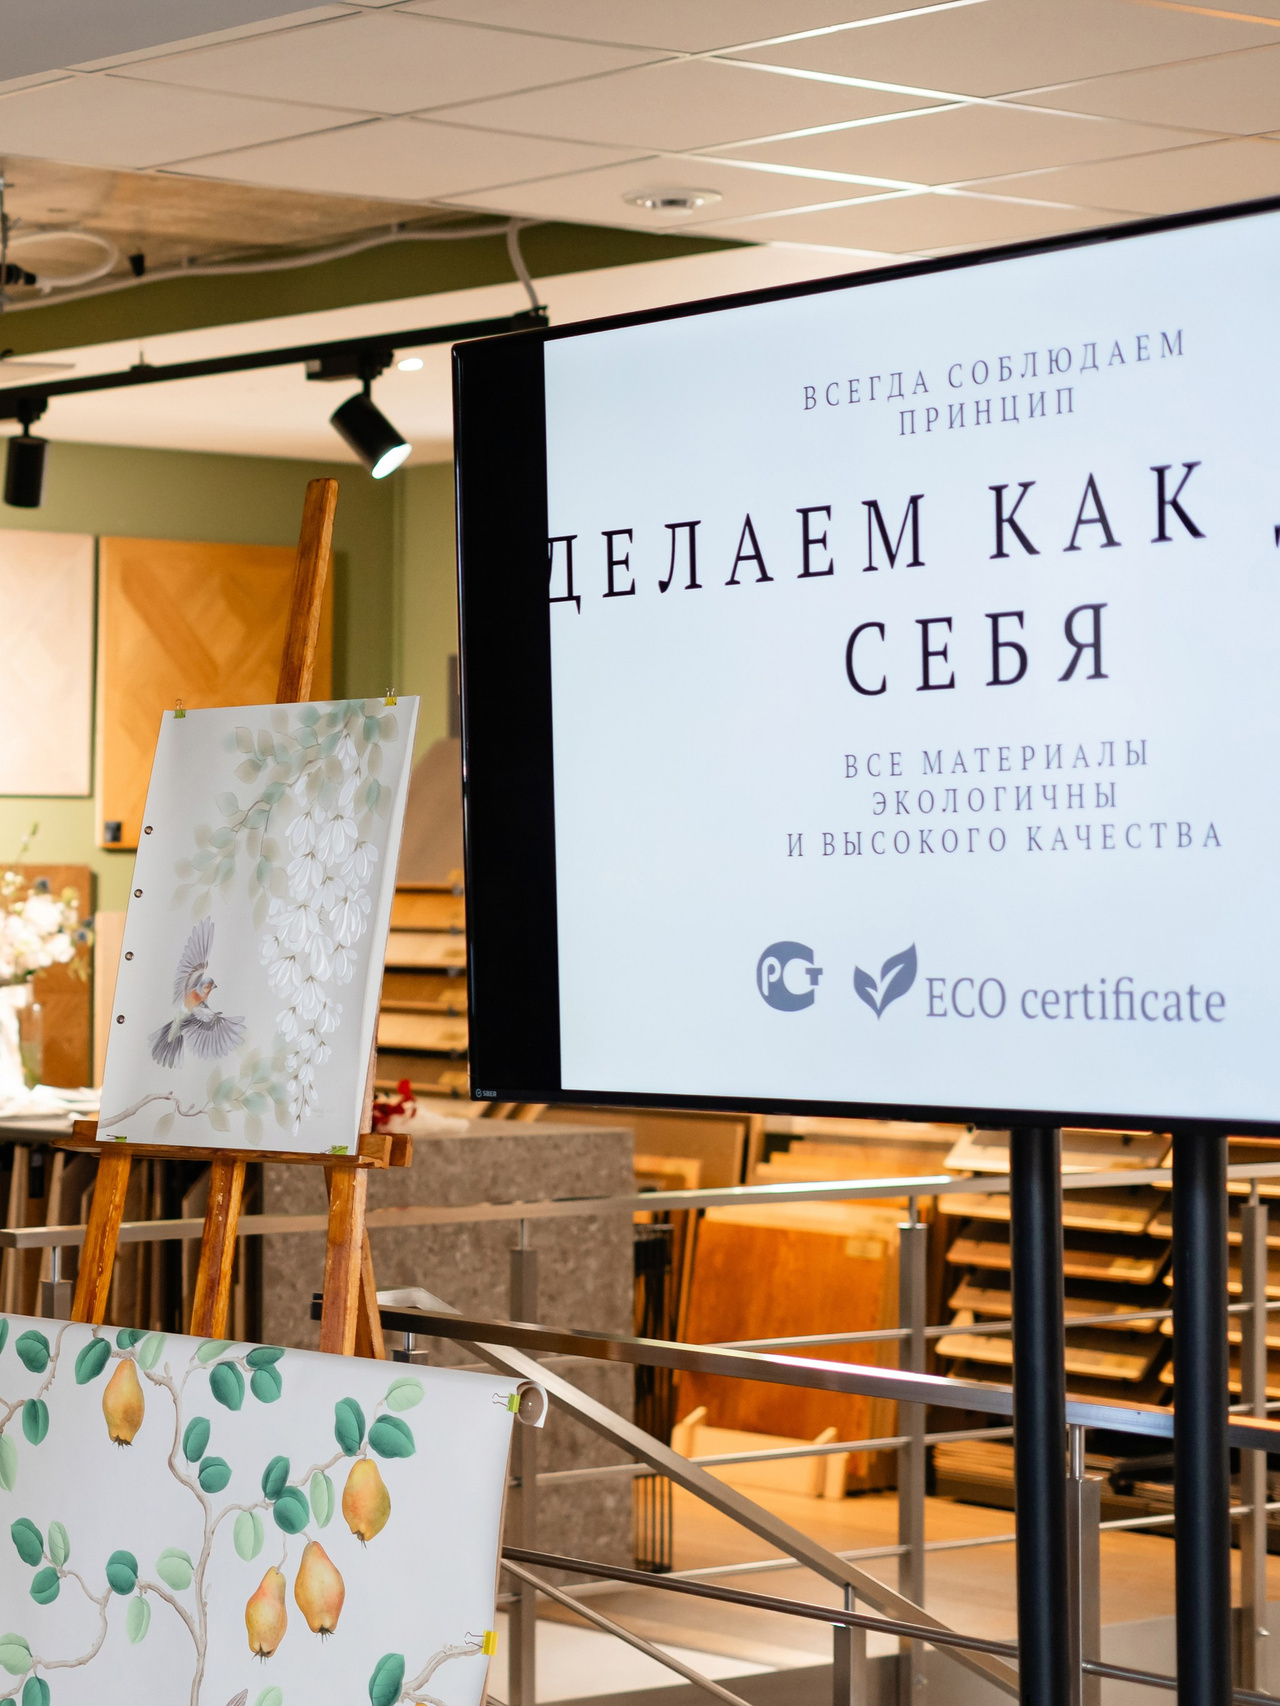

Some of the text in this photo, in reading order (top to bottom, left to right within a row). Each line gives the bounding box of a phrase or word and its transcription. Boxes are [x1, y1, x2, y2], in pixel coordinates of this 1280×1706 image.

[803, 329, 1186, 412] ВСЕГДА СОБЛЮДАЕМ
[898, 386, 1075, 437] ПРИНЦИП
[548, 460, 1208, 615] ДЕЛАЕМ КАК
[844, 602, 1111, 697] СЕБЯ
[844, 739, 1148, 779] ВСЕ МАТЕРИАЛЫ
[871, 781, 1118, 817] ЭКОЛОГИЧНЫ
[786, 820, 1223, 857] И ВЫСОКОГО КАЧЕСТВА
[925, 976, 1227, 1024] ECO certificate
